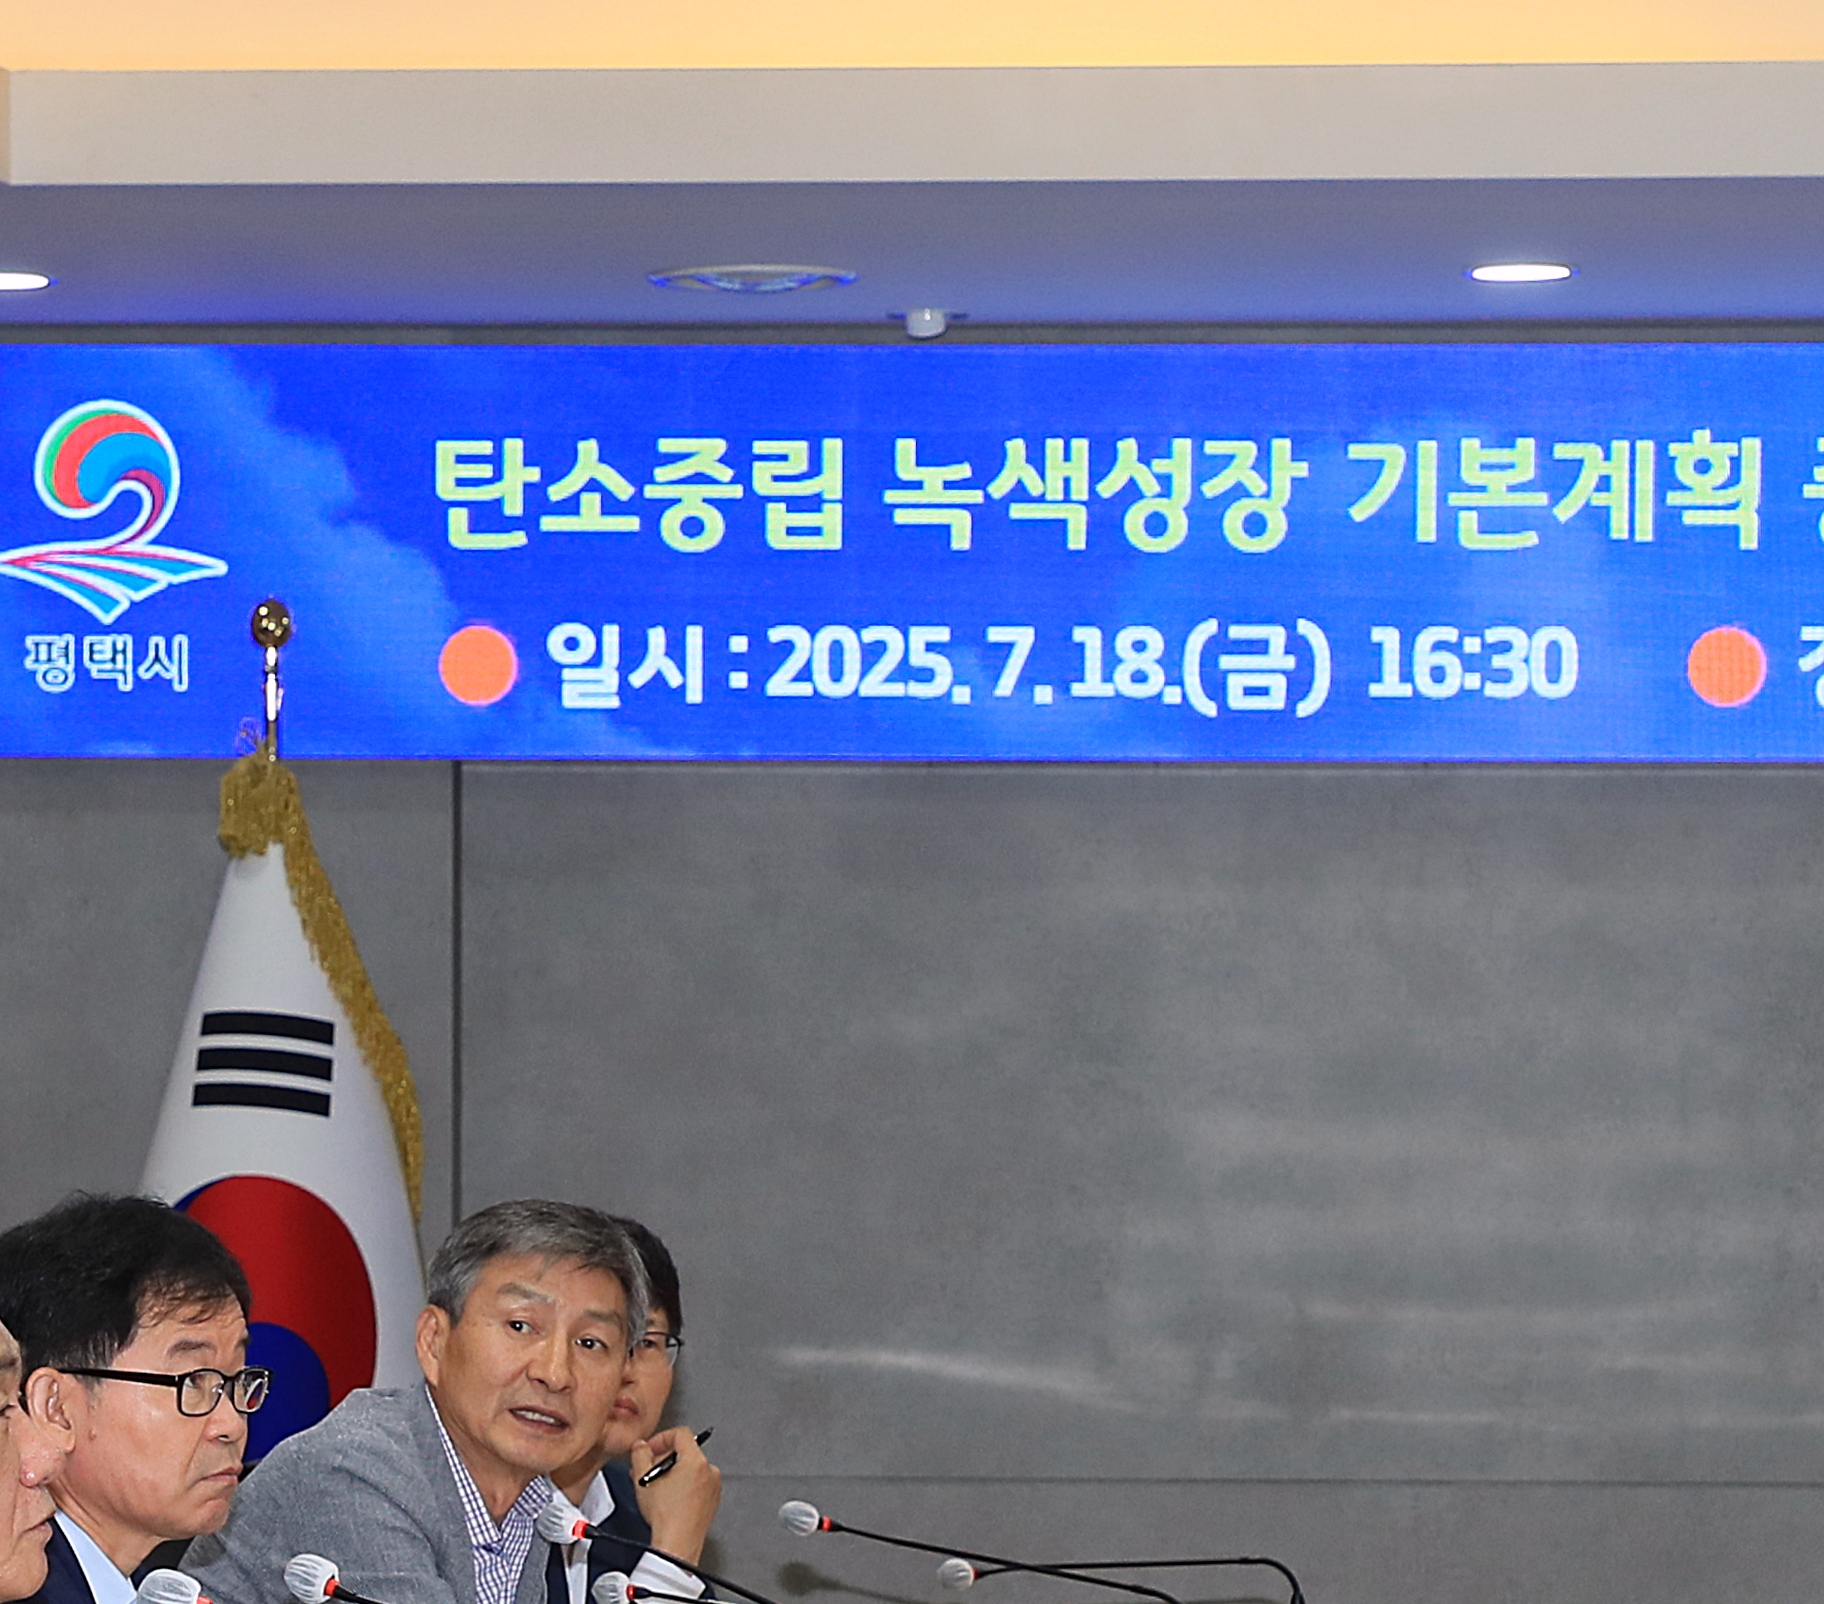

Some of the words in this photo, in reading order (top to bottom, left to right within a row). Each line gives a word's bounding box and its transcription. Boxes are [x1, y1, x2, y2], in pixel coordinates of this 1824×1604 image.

[434, 436, 844, 553] 탄소중립
[882, 436, 1311, 554] 녹색성장
[1346, 428, 1763, 552] 기본계획
[24, 633, 189, 693] 평택시
[766, 624, 972, 706] 2025.
[1368, 624, 1581, 700] 16:30
